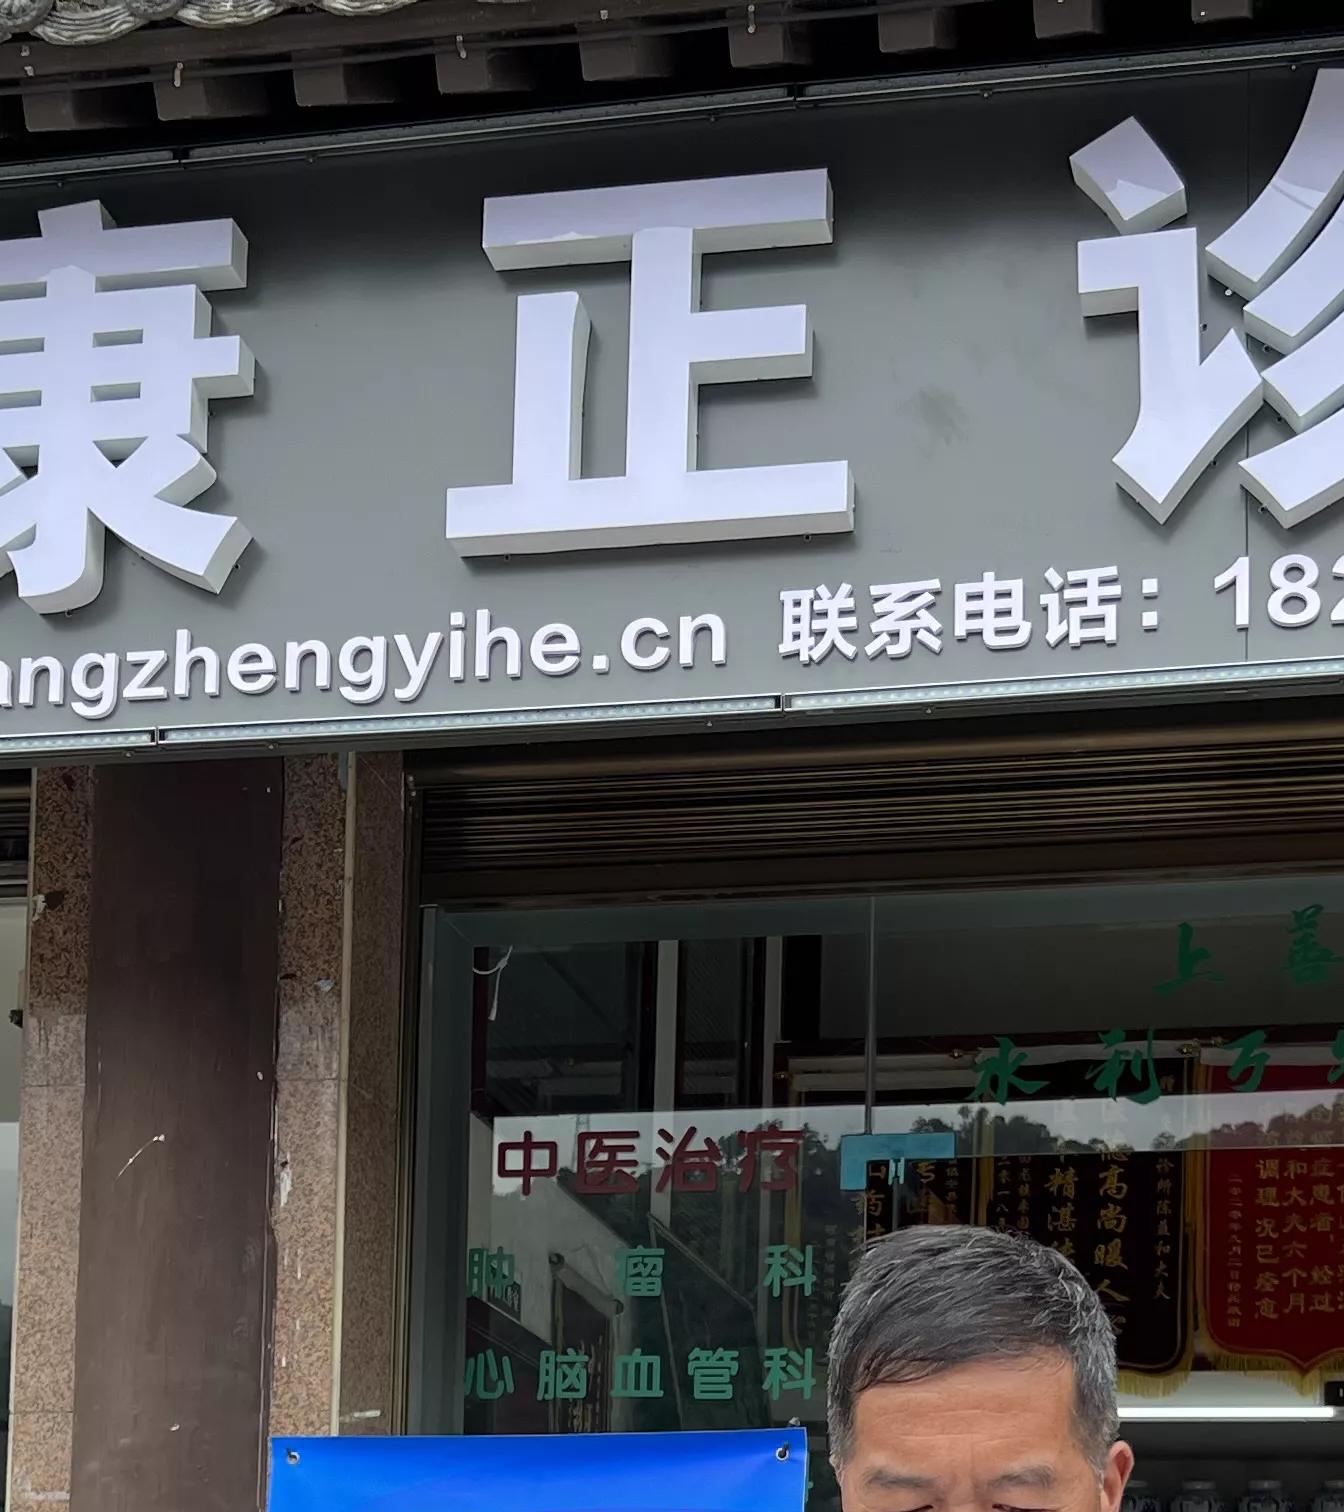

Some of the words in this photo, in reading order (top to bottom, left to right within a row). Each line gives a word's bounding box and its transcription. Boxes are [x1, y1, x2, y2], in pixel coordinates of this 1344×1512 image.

[497, 1126, 808, 1198] 中医治疗
[467, 1243, 816, 1299] 肿瘤科
[463, 1347, 816, 1401] 心脑血管科
